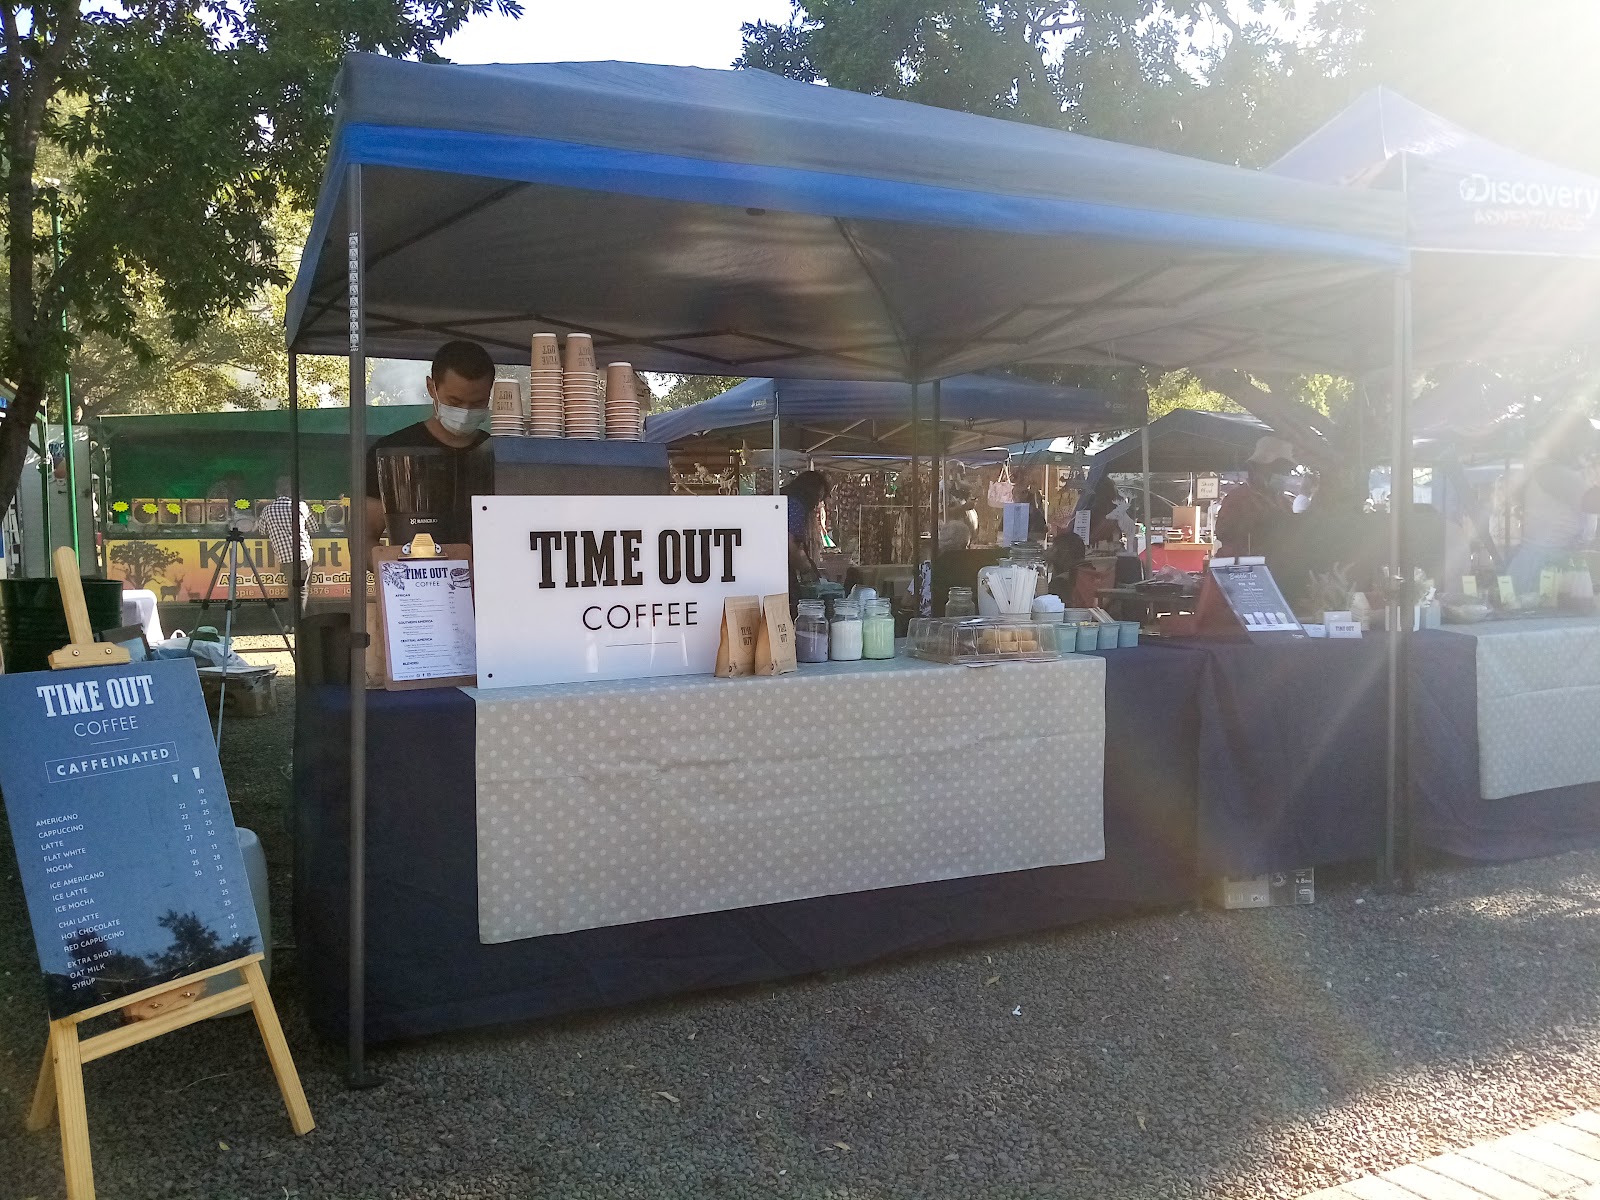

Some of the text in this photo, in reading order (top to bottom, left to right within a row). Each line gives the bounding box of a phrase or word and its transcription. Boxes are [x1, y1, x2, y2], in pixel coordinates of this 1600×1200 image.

[1461, 173, 1599, 219] Discovery
[529, 528, 742, 589] TIME OUT
[405, 567, 449, 580] TIME OUT
[268, 588, 286, 596] 082
[582, 602, 698, 631] COFFEE
[36, 674, 154, 718] TIME OUT
[74, 715, 139, 737] COFFEE
[56, 748, 170, 776] CAFFEINATED
[35, 813, 79, 827] AMERICANO
[38, 824, 84, 839] CAPPUCCINO
[40, 840, 64, 851] LATTE
[43, 853, 62, 862] FLAT
[63, 847, 87, 858] WHITE
[46, 862, 73, 874] MOCHA
[49, 881, 62, 890] ICE
[63, 871, 105, 887] AMERICANO
[52, 893, 64, 902] ICE
[65, 887, 88, 898] LATTE
[54, 904, 67, 914] ICE
[68, 898, 95, 910] MOCHA
[58, 918, 76, 929] CHAI
[77, 912, 100, 924] LATTE
[61, 931, 77, 941] HOT
[78, 919, 121, 936] CHOCOLATE
[63, 943, 79, 953] RED
[80, 930, 125, 948] CAPPUCCINO
[67, 956, 92, 969] EXTRA
[93, 949, 113, 961] SHOT
[69, 969, 85, 979] OAT
[87, 963, 106, 974] MILK
[71, 977, 96, 991] SYRUP
